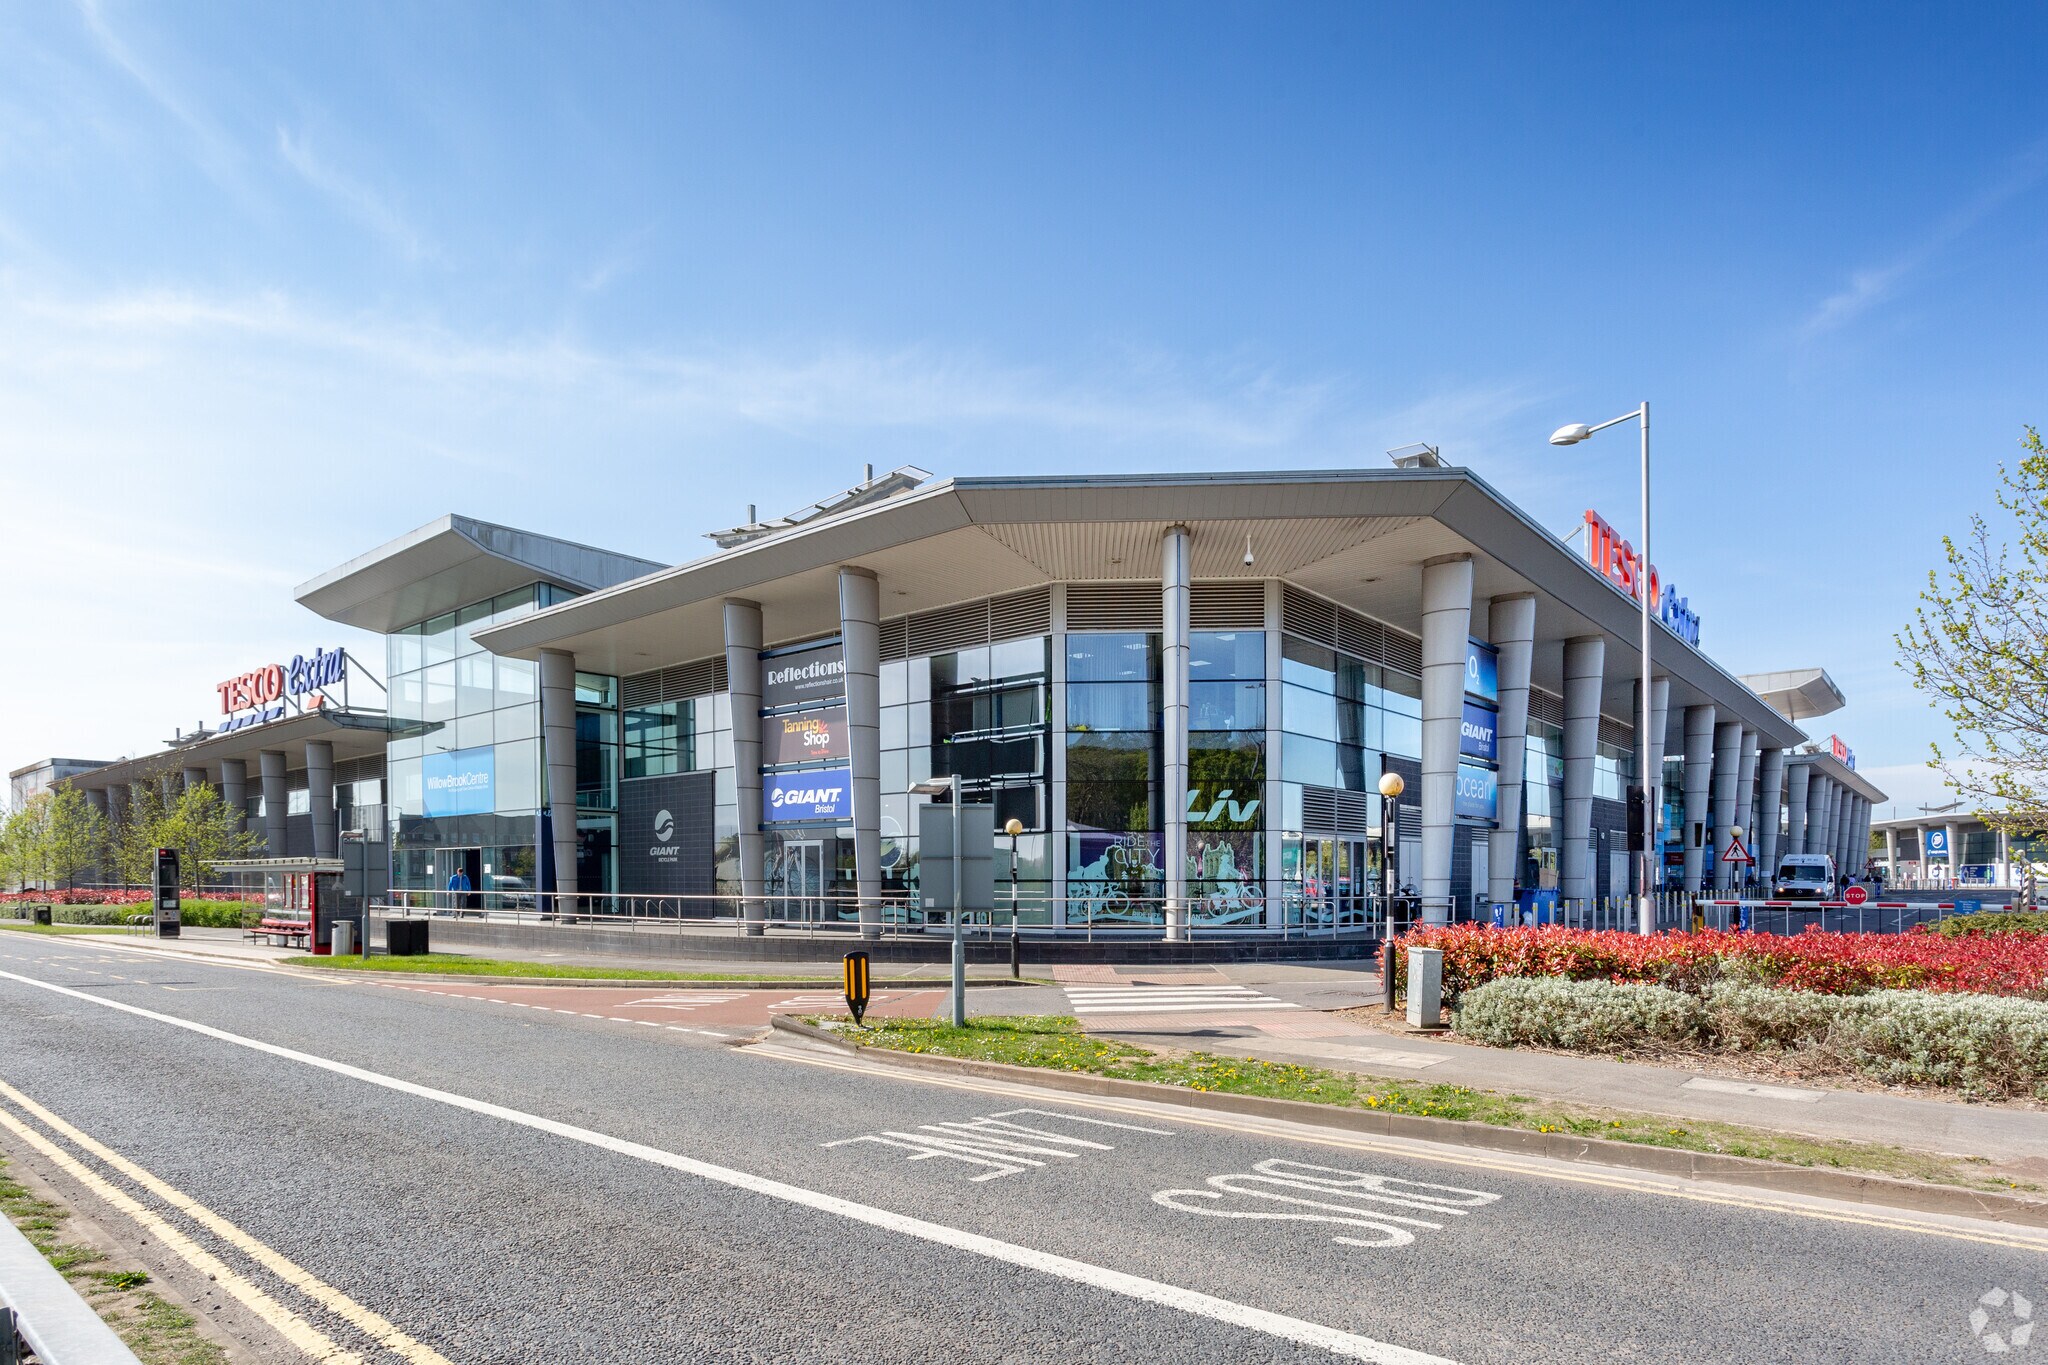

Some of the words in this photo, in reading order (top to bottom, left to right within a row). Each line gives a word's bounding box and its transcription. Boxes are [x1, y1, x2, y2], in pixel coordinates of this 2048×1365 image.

[1585, 509, 1660, 614] TESCO
[217, 663, 283, 715] TESCO
[288, 647, 345, 695] extra
[768, 660, 844, 686] Reflections
[1469, 655, 1480, 685] O2
[782, 717, 820, 734] Tanning
[1460, 721, 1493, 742] GIANT
[803, 731, 830, 748] Shop
[785, 788, 842, 804] GIANT
[1456, 775, 1491, 801] ocean
[815, 803, 836, 815] Bristol
[1187, 789, 1261, 823] Liv
[649, 846, 680, 856] GIANT
[1114, 836, 1145, 847] RIDE
[1114, 848, 1160, 864] CITY
[820, 1108, 1175, 1181] LANE
[1152, 1158, 1503, 1247] BUS
